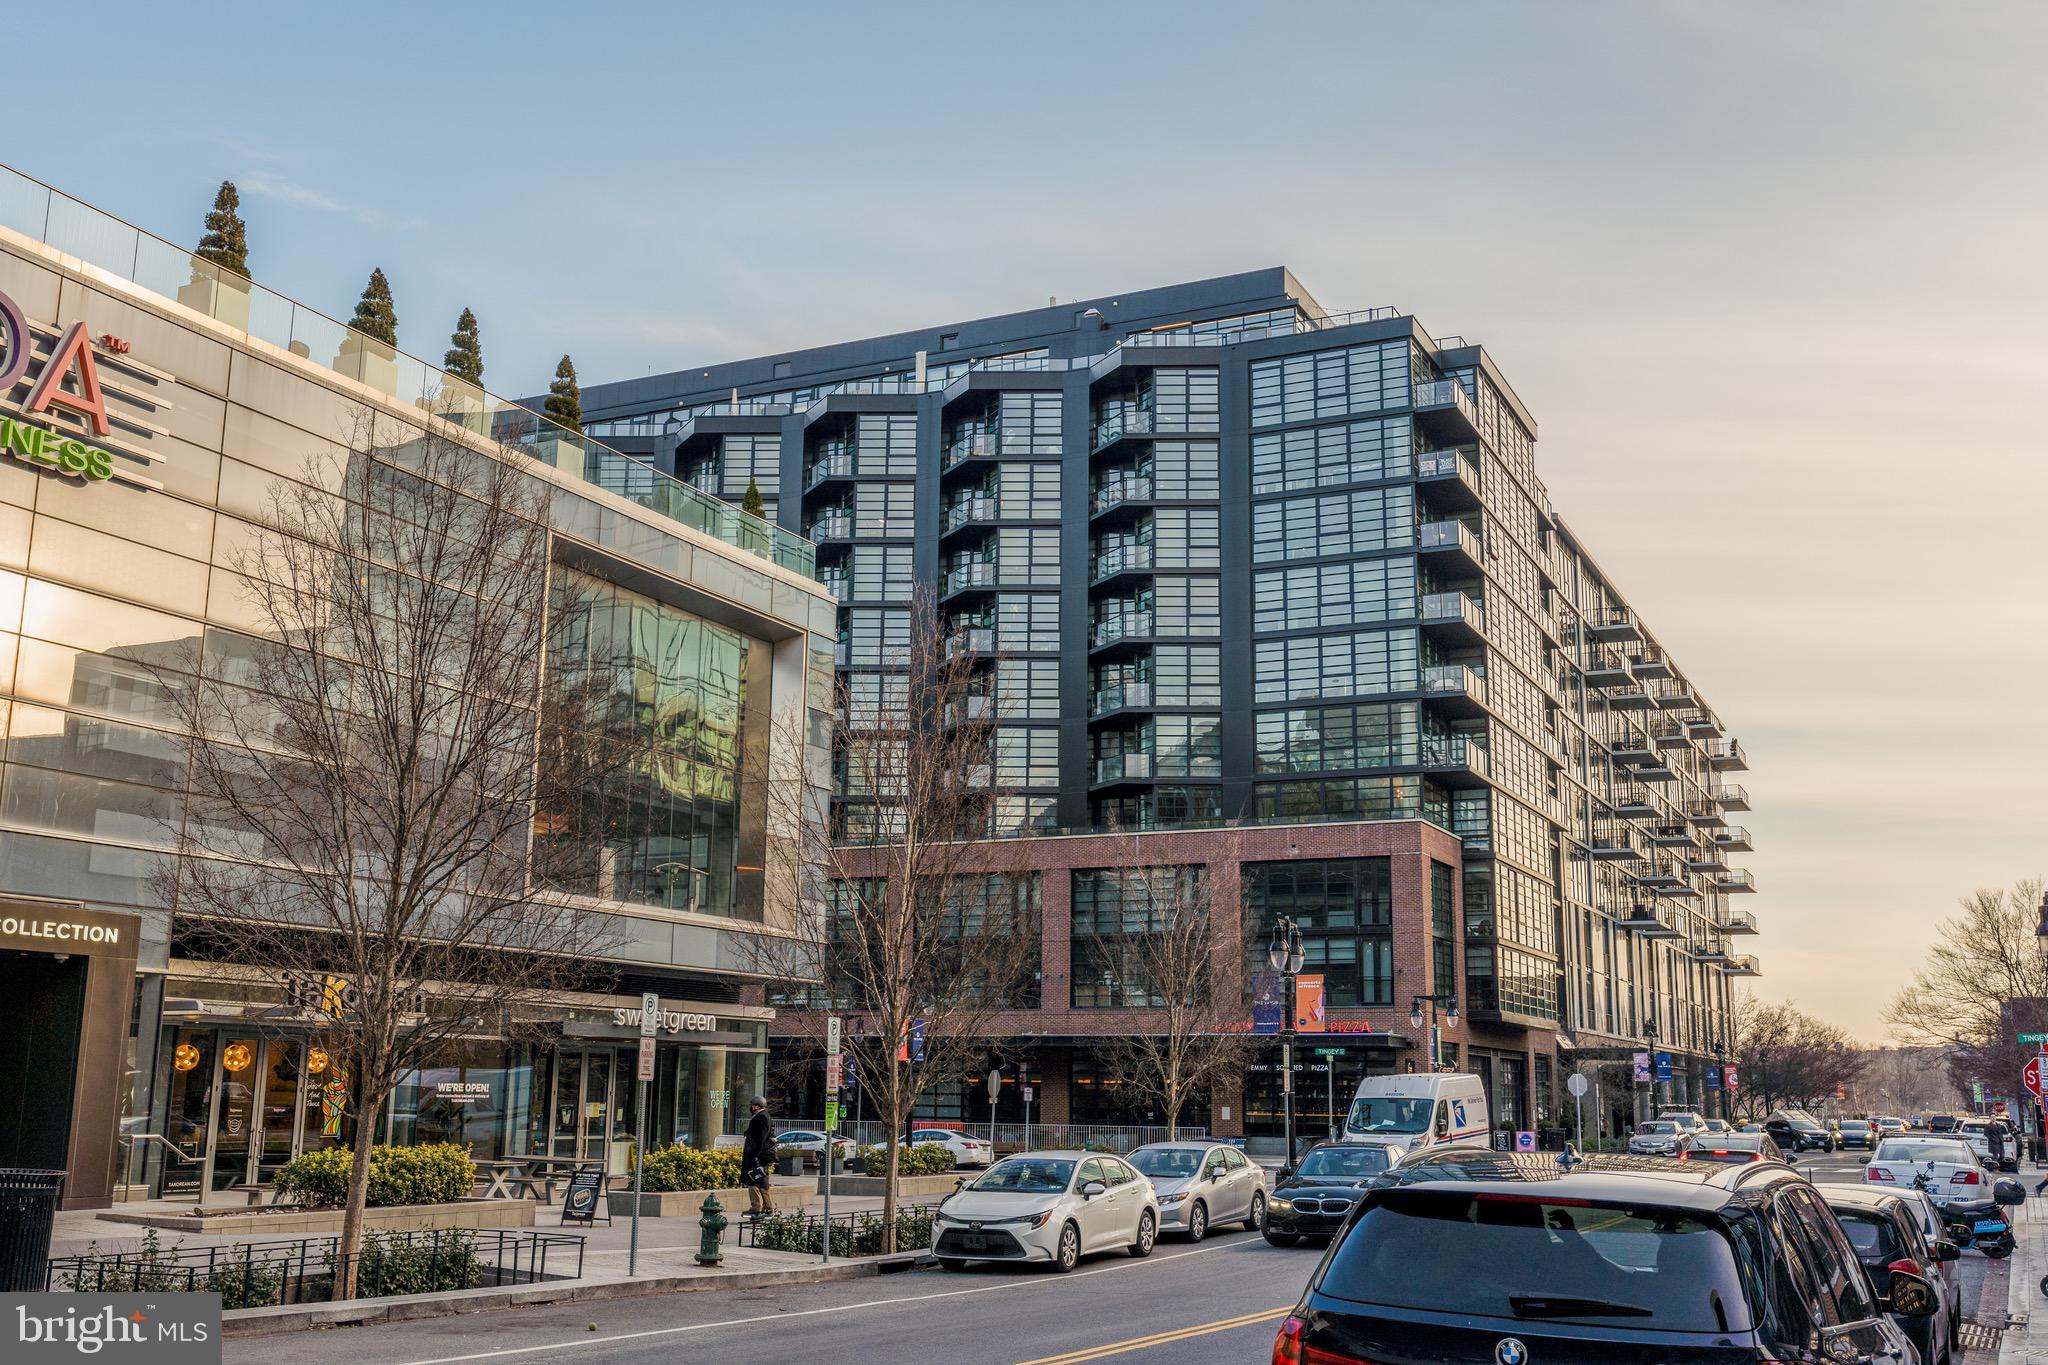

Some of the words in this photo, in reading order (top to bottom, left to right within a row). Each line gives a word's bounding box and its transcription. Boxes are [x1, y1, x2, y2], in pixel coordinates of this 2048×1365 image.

[0, 416, 114, 481] NESS
[0, 918, 119, 944] OLLECTION
[613, 1008, 717, 1034] swetgreen
[1330, 1021, 1373, 1033] PIZZA
[437, 1083, 464, 1092] WE'RE
[465, 1084, 489, 1092] OPEN!
[711, 1100, 729, 1108] OPEN
